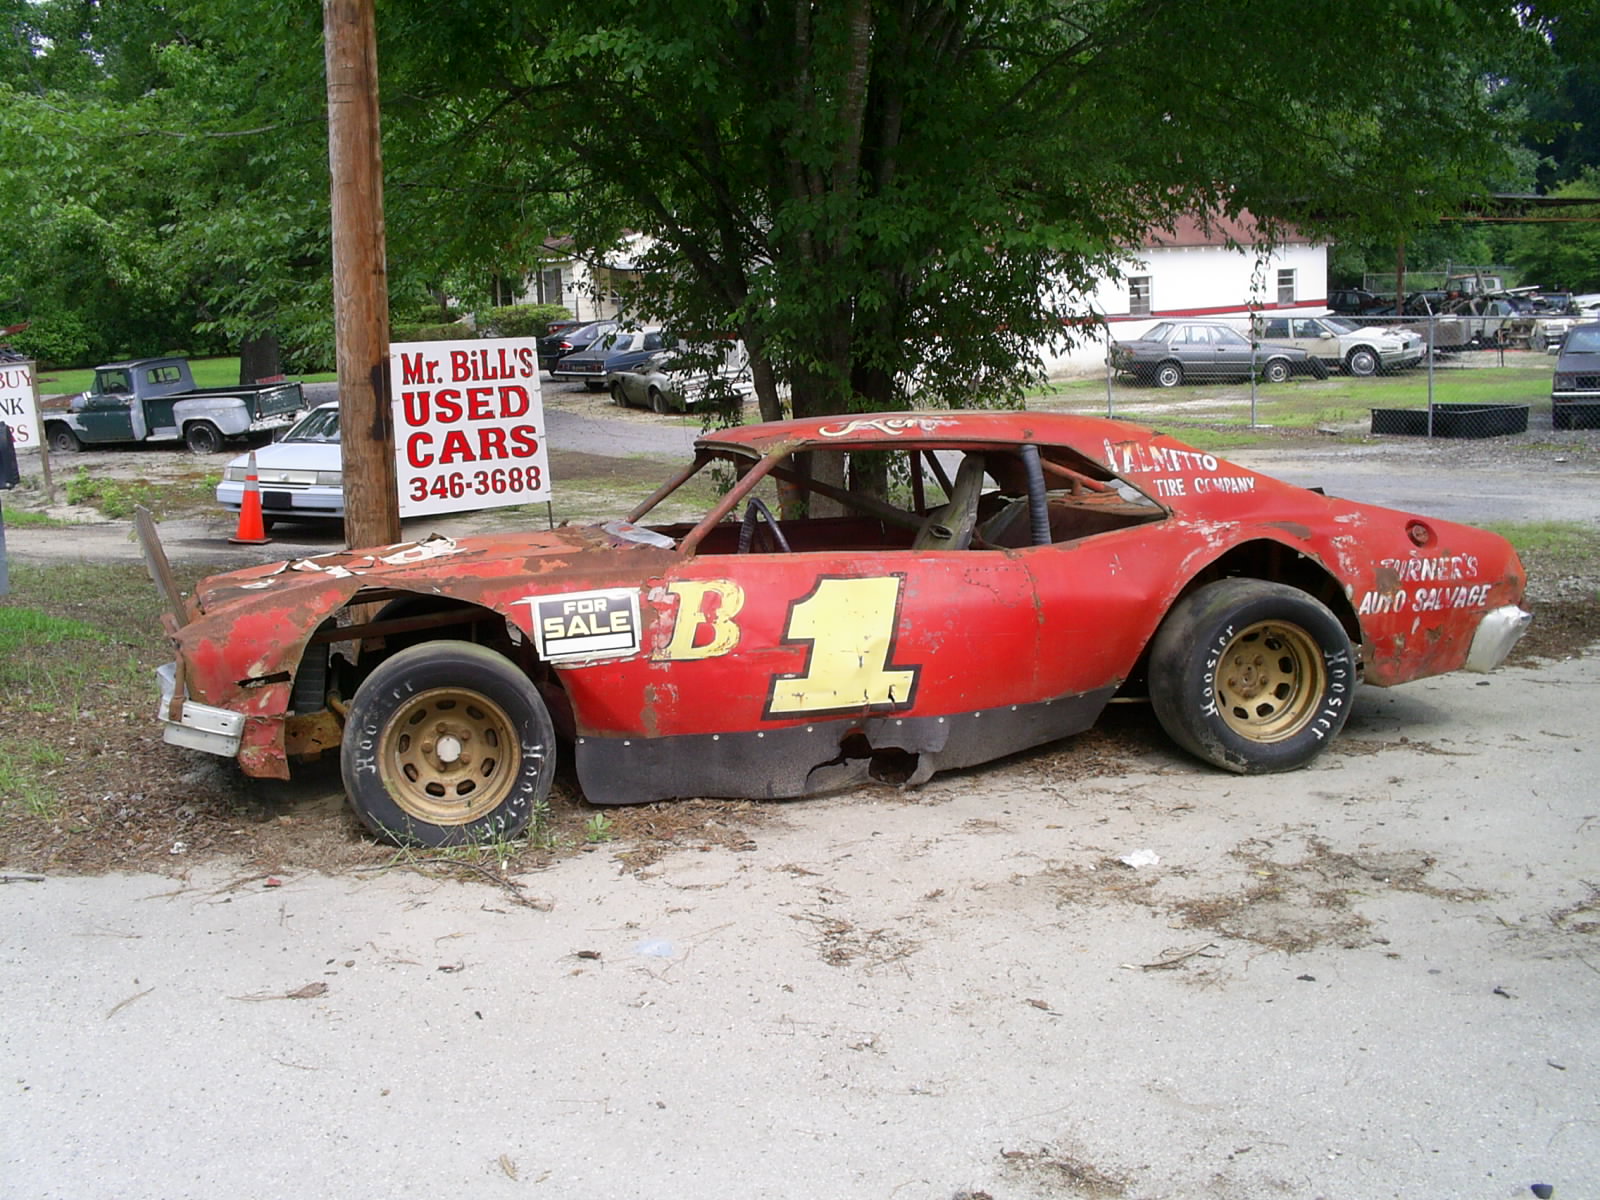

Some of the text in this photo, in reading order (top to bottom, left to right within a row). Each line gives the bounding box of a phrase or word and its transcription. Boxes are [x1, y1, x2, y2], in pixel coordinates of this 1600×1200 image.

[401, 352, 443, 385] Mr.
[401, 385, 530, 427] USED
[406, 425, 539, 468] CARS
[409, 466, 541, 502] 346-3688
[1153, 477, 1186, 497] TIRE
[563, 598, 608, 615] FOR
[1359, 584, 1491, 615] AUTO SALVAGE
[543, 610, 631, 639] SALE
[651, 572, 921, 721] B 1
